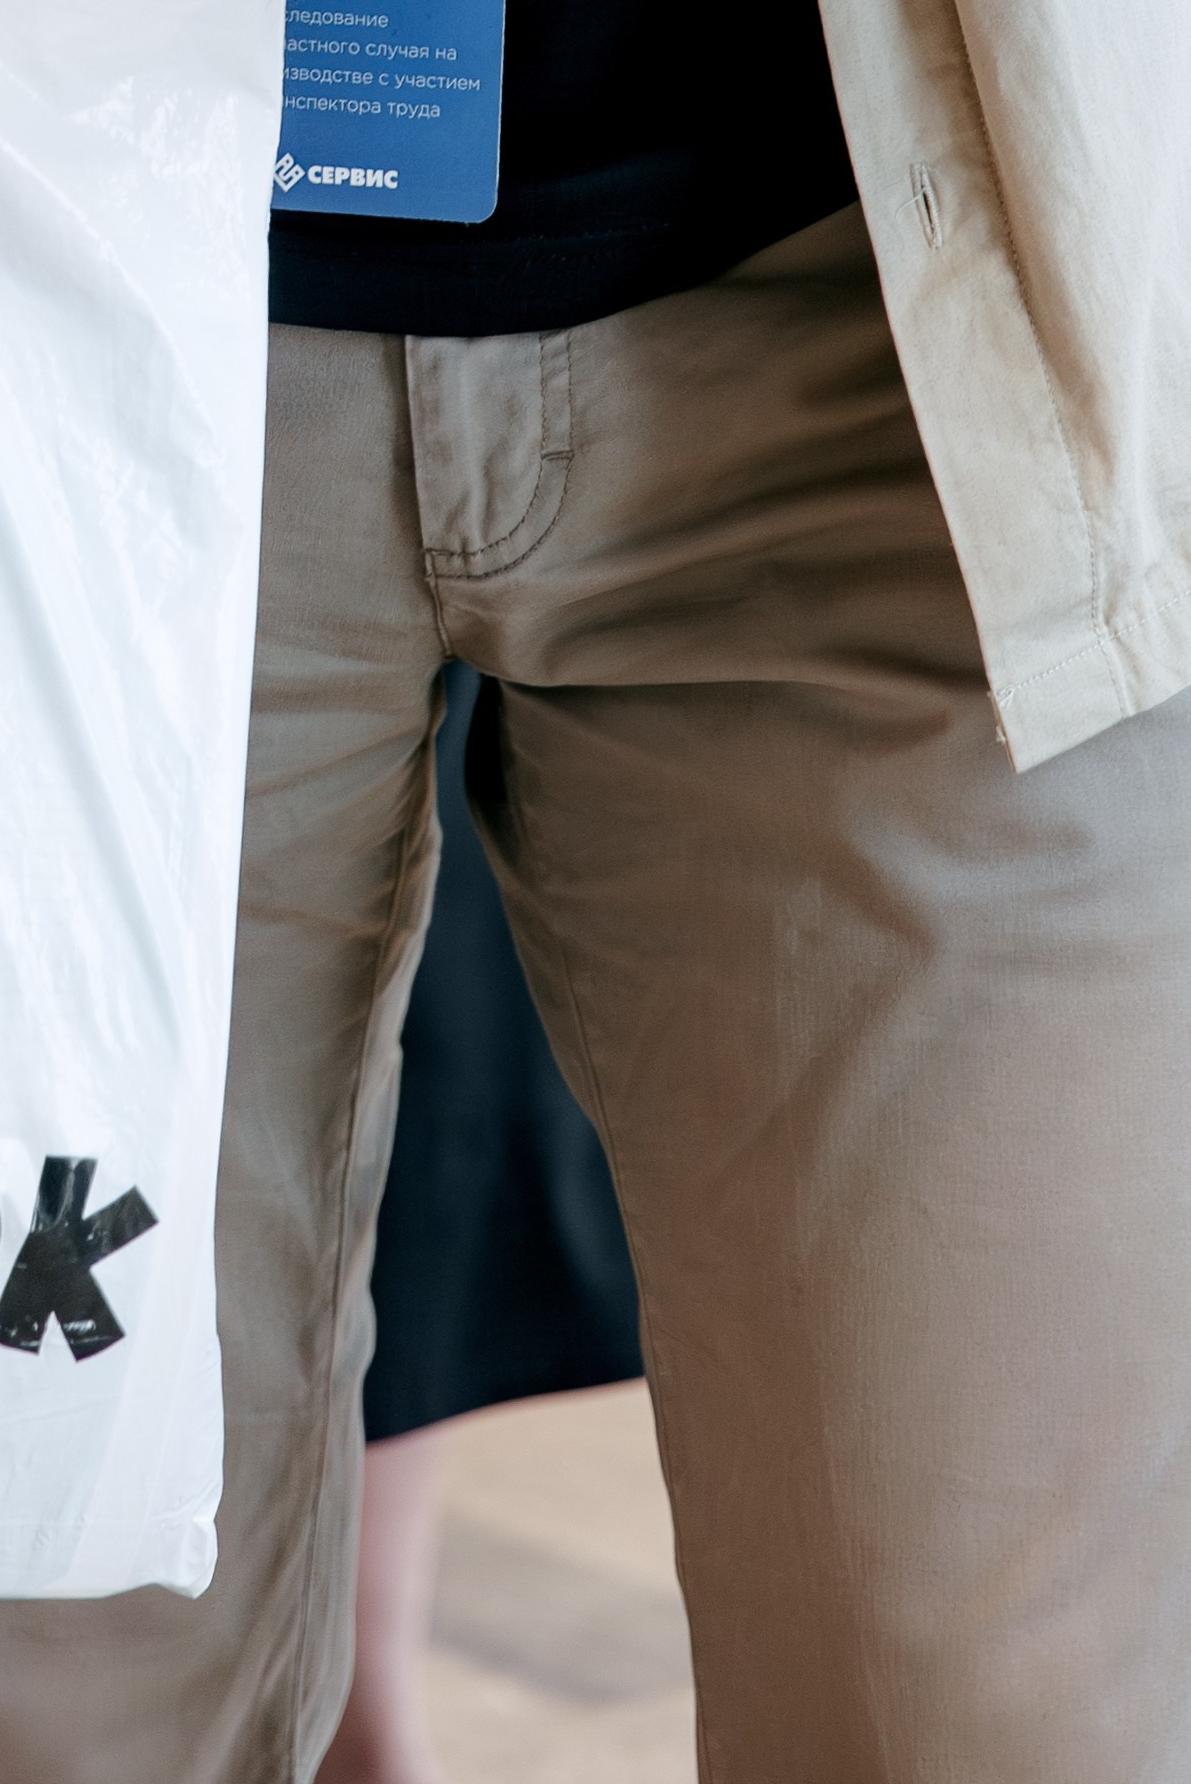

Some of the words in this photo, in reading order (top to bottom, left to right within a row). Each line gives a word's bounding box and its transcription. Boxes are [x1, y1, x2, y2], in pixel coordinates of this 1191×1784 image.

[284, 38, 360, 56] астного
[365, 42, 430, 60] случая
[435, 47, 458, 62] на
[378, 72, 390, 85] с
[394, 73, 481, 92] участием
[283, 95, 382, 115] нспектора
[387, 100, 441, 119] труда
[307, 165, 399, 190] СЕРВИС
